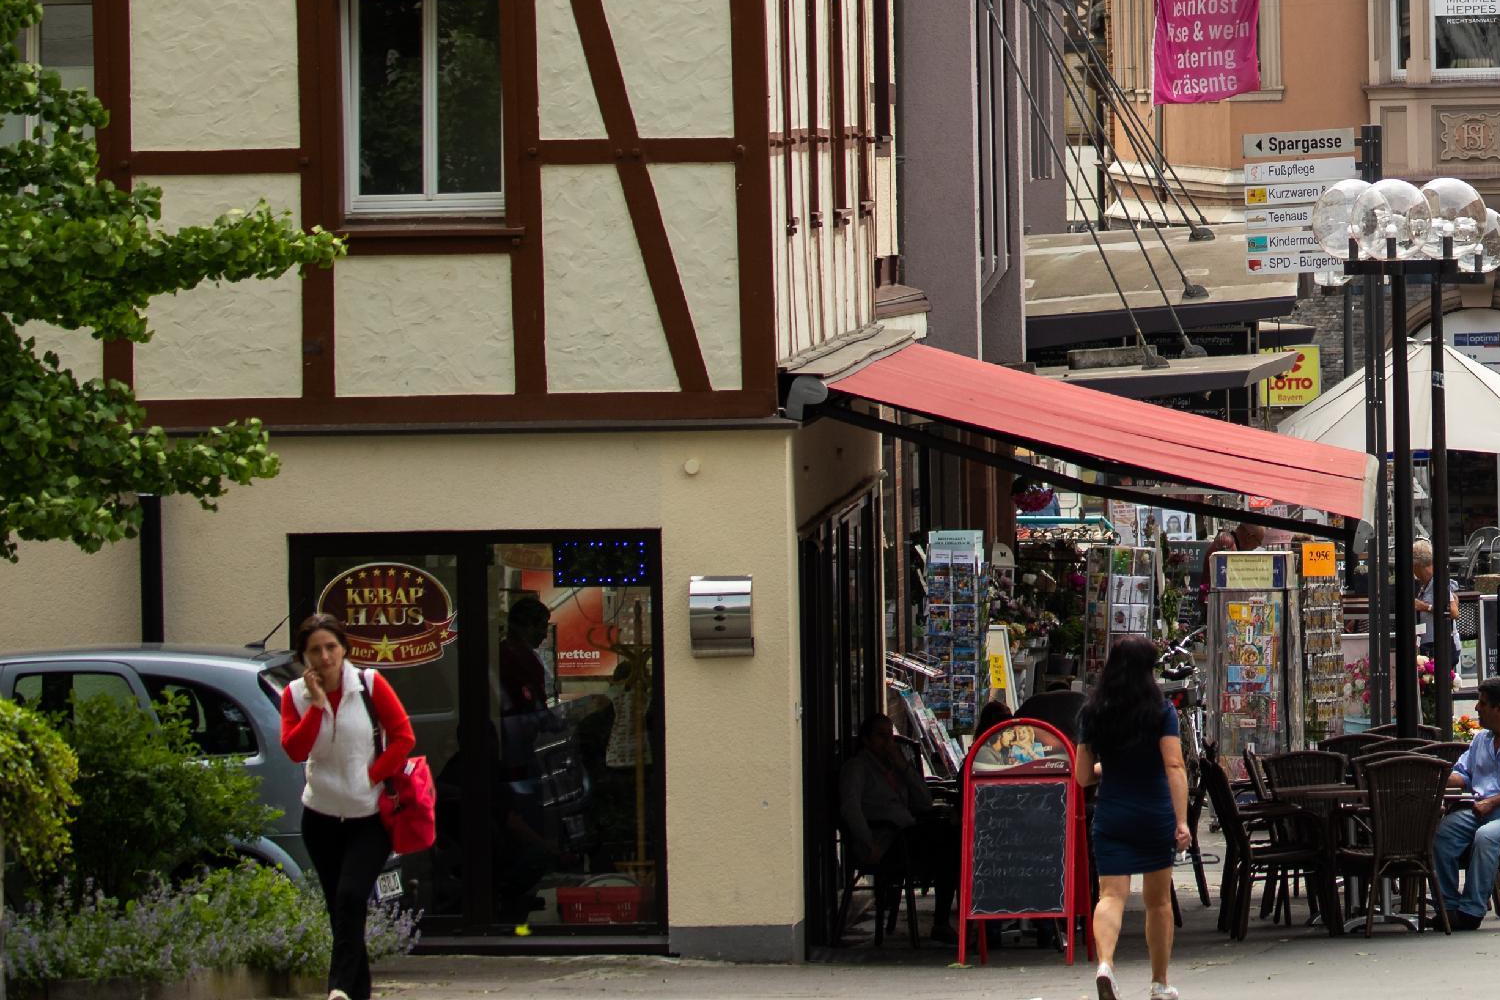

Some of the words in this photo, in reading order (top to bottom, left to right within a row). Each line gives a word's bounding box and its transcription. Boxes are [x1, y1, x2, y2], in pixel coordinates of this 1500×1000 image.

[1446, 4, 1497, 14] HEPPES
[1446, 17, 1497, 25] RECHTSANWALT
[1193, 20, 1204, 42] &
[1208, 19, 1250, 41] wein
[1174, 46, 1237, 70] atering
[1268, 136, 1342, 154] Spargasse
[1268, 164, 1315, 177] Fußpflege
[1268, 187, 1319, 199] Kurzwaren
[1268, 211, 1308, 222] Teehaus
[1268, 257, 1291, 269] SPD
[1469, 334, 1500, 344] optimal
[1268, 377, 1313, 390] LOTTO
[1277, 393, 1303, 402] Bayern
[1308, 550, 1331, 564] 2,95€
[345, 587, 424, 605] KEBAP
[345, 606, 425, 626] HAUS
[399, 640, 438, 658] Pizza
[558, 649, 600, 660] retten
